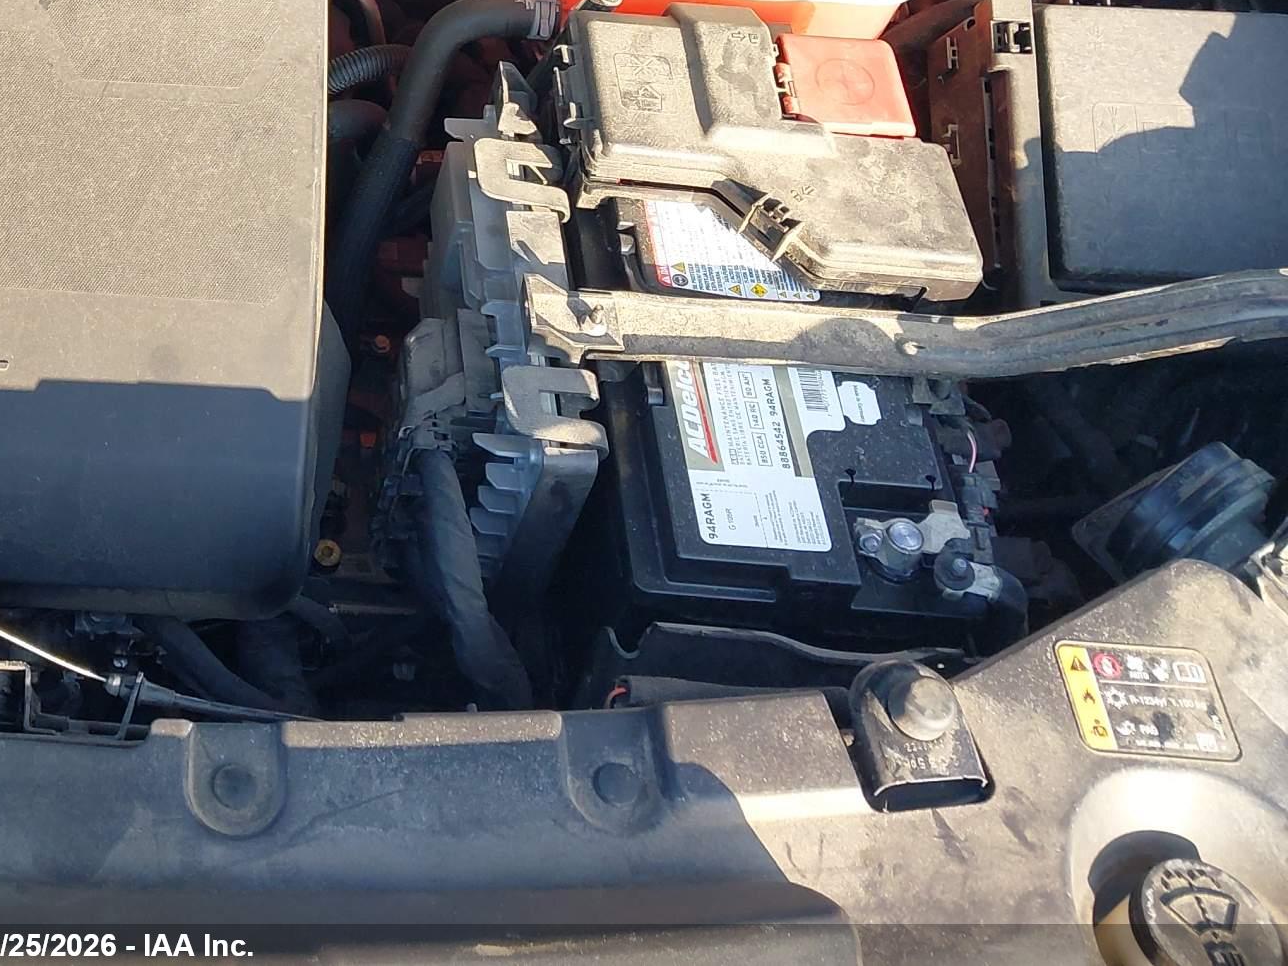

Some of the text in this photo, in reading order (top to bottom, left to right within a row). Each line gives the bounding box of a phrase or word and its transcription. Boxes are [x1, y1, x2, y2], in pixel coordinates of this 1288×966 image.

[761, 378, 779, 416] 94RAGM
[772, 421, 791, 469] 88864542
[700, 493, 718, 539] 94RAGM
